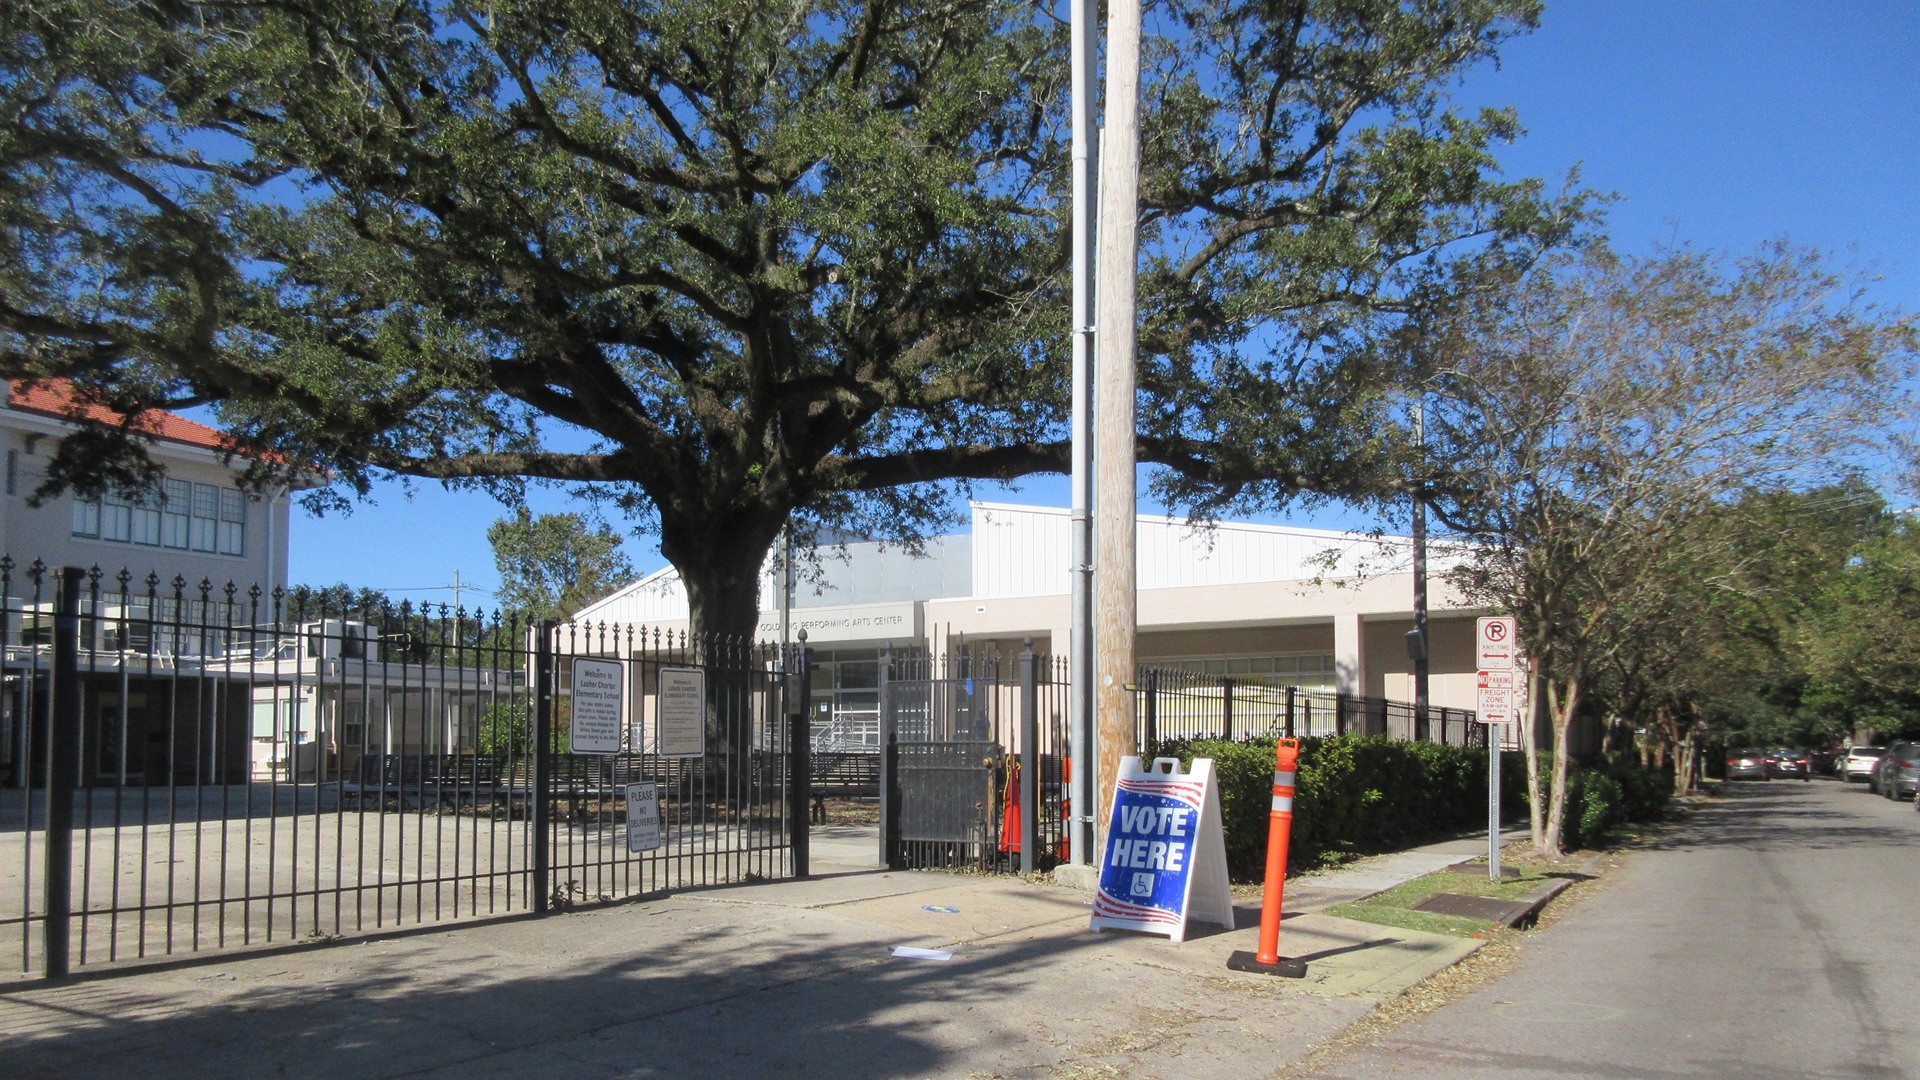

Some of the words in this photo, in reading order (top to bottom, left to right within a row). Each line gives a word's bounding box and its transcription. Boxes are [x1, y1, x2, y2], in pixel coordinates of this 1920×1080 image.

[801, 618, 850, 630] PERFORMING
[852, 617, 871, 627] ARTS
[874, 616, 903, 626] CENTER
[584, 670, 606, 679] Welcome
[1478, 674, 1488, 684] NO
[1489, 676, 1511, 684] PARKING
[598, 681, 616, 690] Charter
[576, 689, 602, 699] Elementary
[604, 692, 620, 700] School
[631, 790, 653, 801] PLEASE
[631, 817, 657, 827] DELIVERIES
[1121, 805, 1189, 837] VOTE
[1111, 838, 1185, 871] HERE
